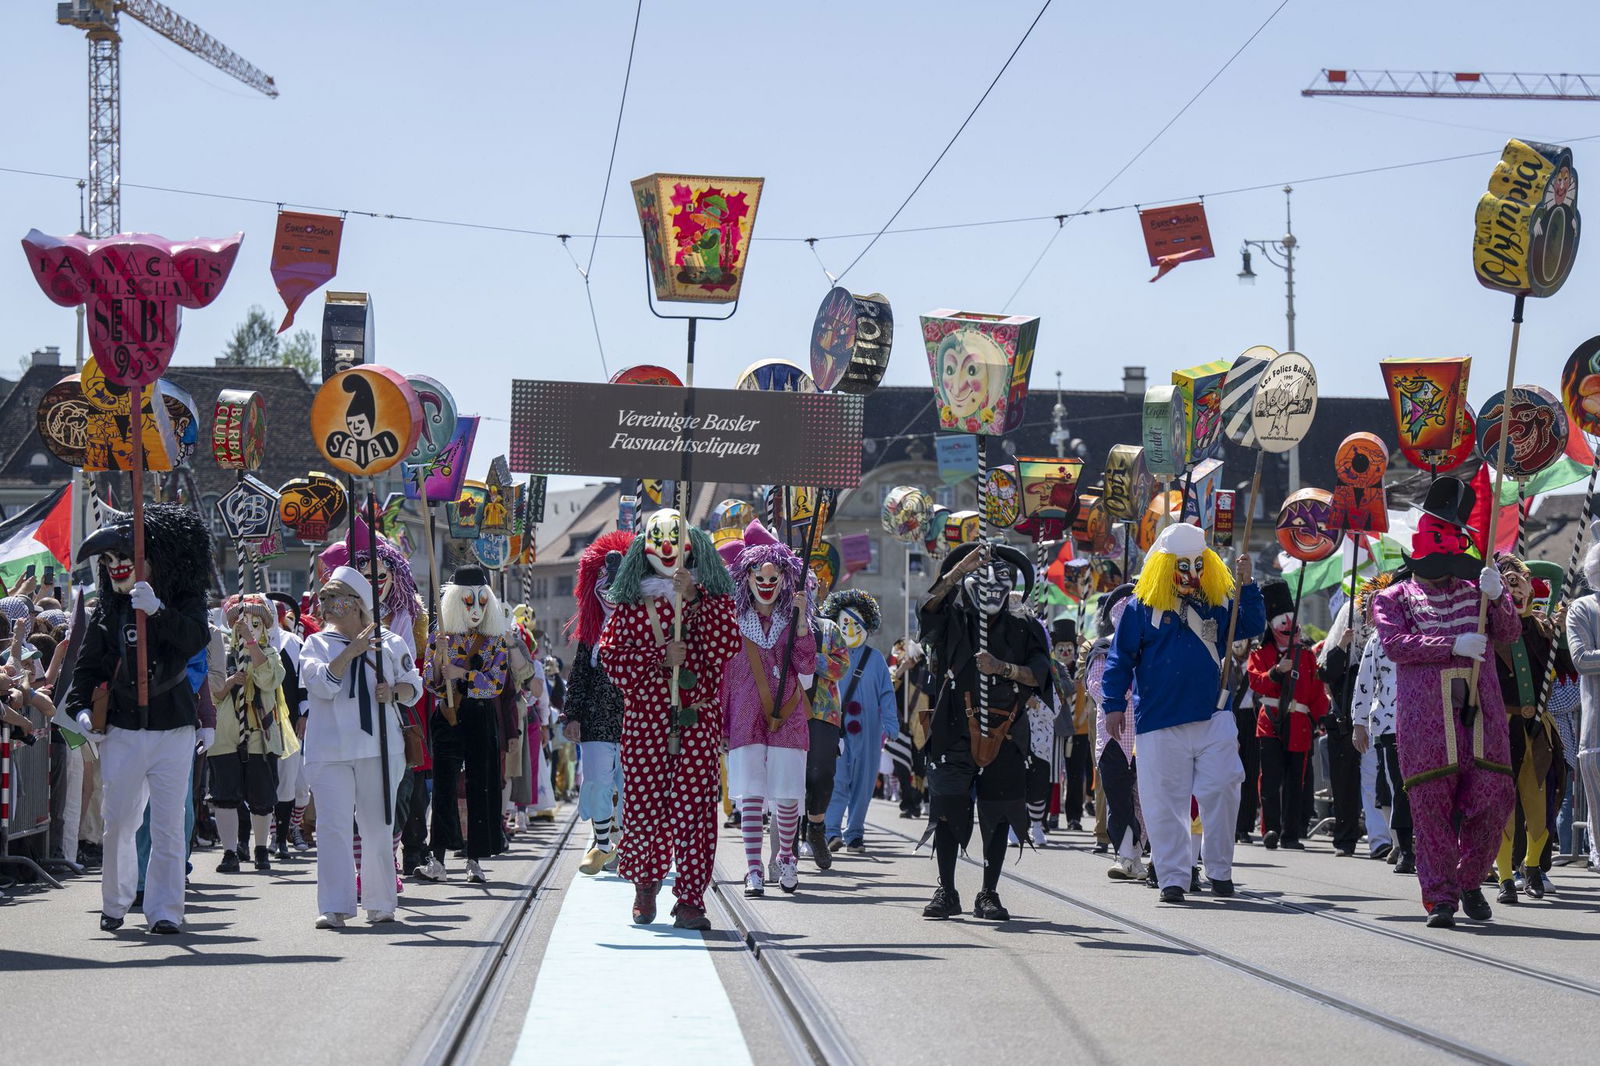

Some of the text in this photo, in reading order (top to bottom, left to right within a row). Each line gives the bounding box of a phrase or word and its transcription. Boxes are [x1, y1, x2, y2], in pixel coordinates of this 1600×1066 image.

[1480, 155, 1543, 286] Olympia
[94, 298, 167, 345] SEIBI
[1260, 376, 1272, 389] Les
[215, 406, 229, 444] CLUB
[617, 409, 760, 432] Vereinigte Basler
[330, 434, 393, 464] SEIBI
[609, 432, 761, 458] Fasnachtscliquen
